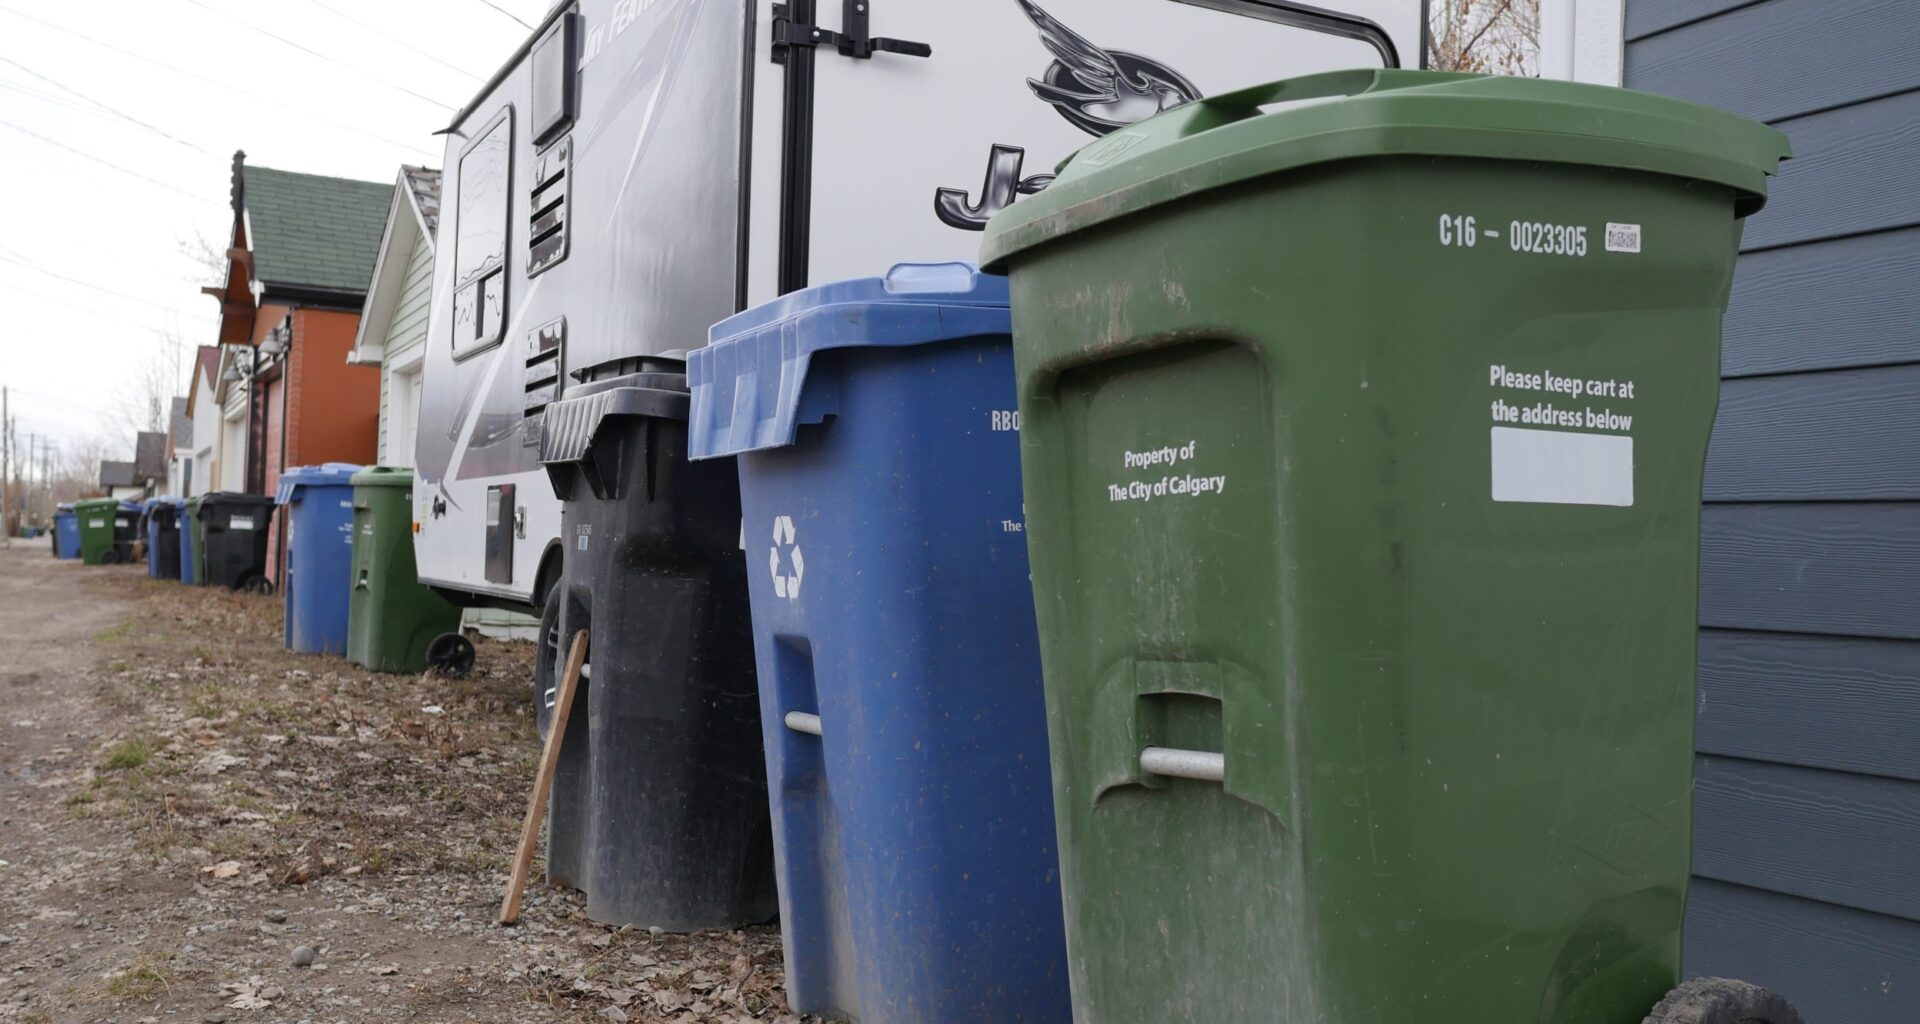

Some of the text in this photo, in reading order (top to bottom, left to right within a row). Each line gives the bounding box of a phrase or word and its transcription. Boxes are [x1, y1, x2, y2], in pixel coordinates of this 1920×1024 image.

[608, 0, 656, 44] FEA
[1439, 213, 1476, 247] C16
[1510, 220, 1587, 256] 0023305
[1490, 364, 1634, 399] Please keep cart at
[1491, 399, 1632, 430] the address below
[1125, 440, 1196, 470] Property of
[1108, 474, 1226, 502] The City of Calgary
[1001, 520, 1022, 532] The
